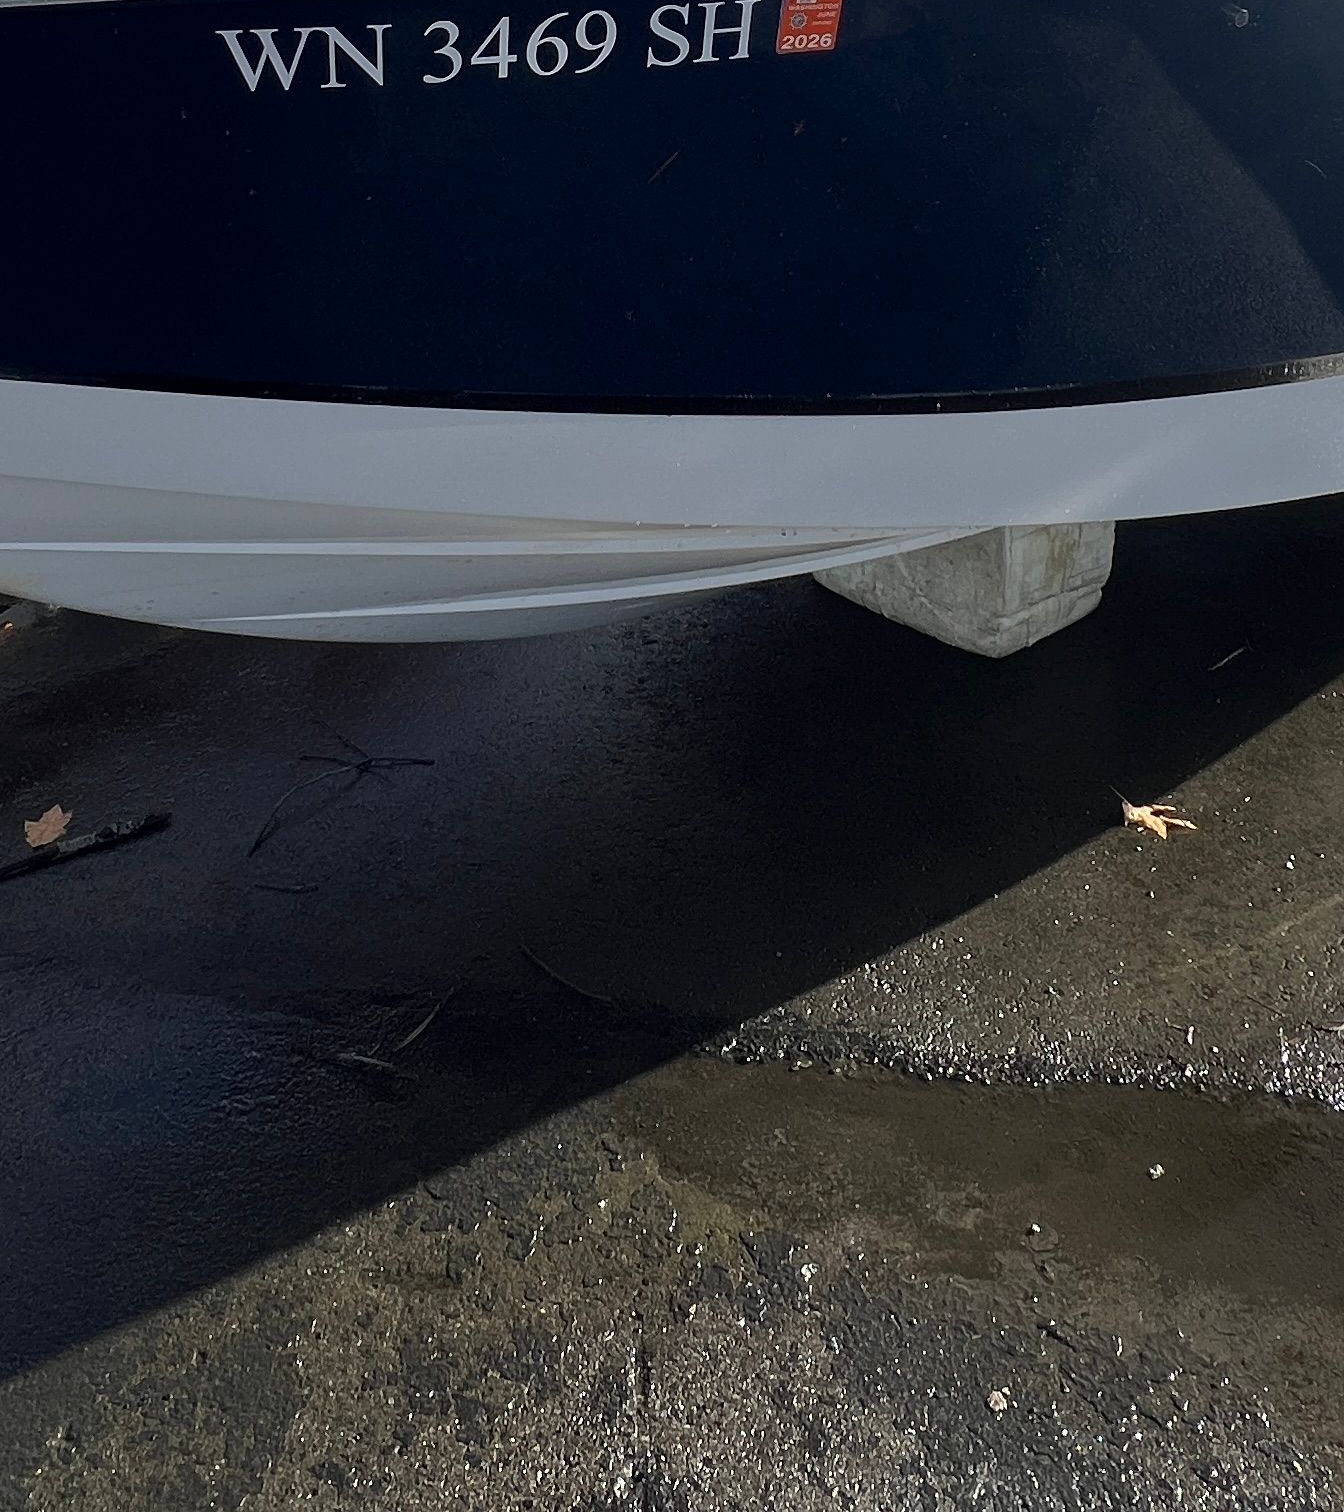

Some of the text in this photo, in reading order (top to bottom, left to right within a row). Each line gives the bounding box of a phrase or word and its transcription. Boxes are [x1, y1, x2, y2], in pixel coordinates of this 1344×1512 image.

[215, 24, 392, 92] WN
[422, 10, 618, 85] 3469
[781, 33, 833, 50] 2026
